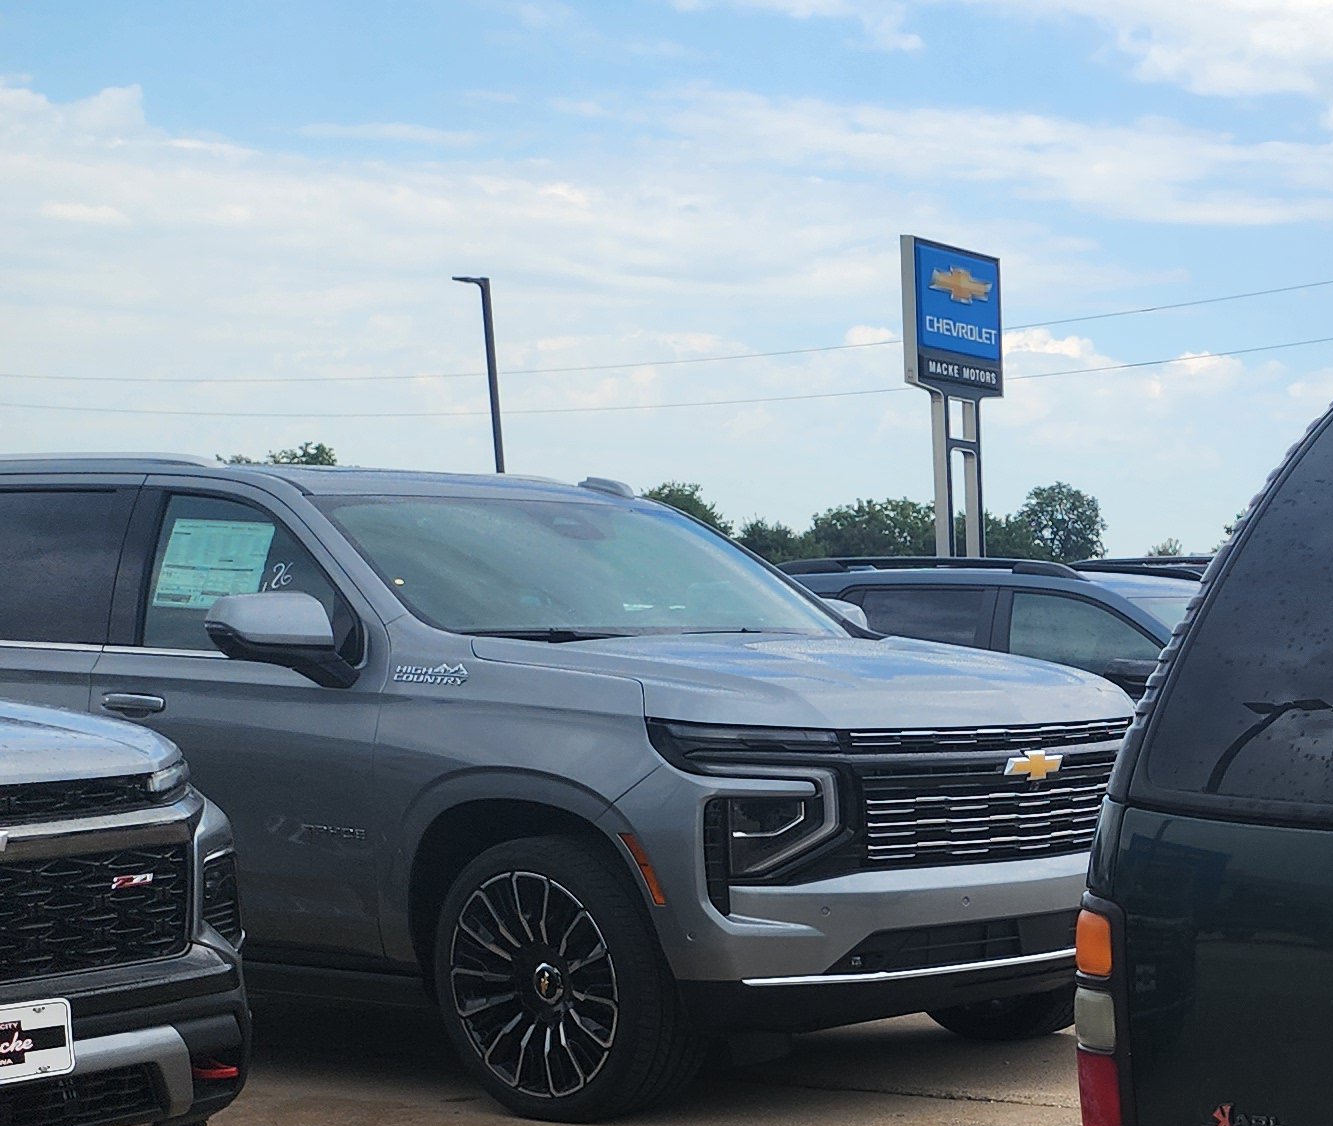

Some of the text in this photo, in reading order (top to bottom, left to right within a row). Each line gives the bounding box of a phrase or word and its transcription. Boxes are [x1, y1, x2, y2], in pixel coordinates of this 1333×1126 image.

[926, 315, 997, 345] CHEVROLET
[929, 360, 997, 385] MACKE MOTORS
[396, 665, 434, 674] HIGH
[393, 673, 467, 685] COUNTRY
